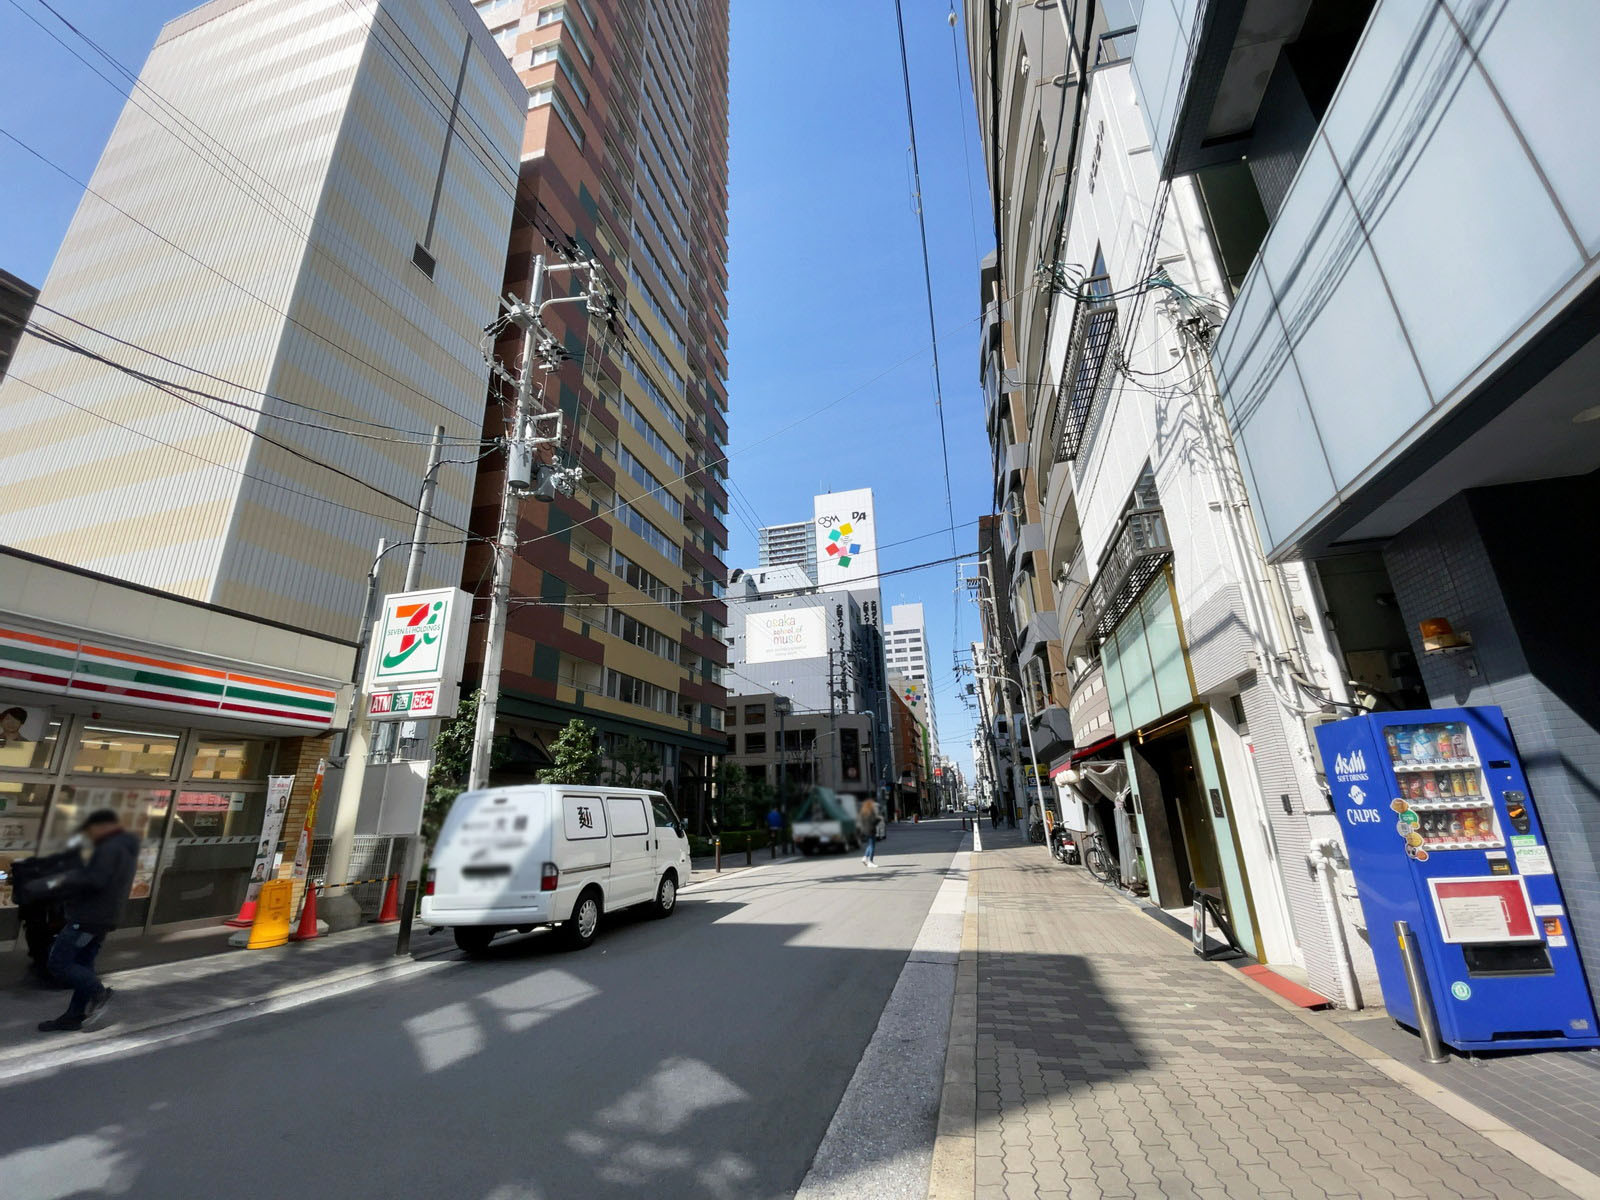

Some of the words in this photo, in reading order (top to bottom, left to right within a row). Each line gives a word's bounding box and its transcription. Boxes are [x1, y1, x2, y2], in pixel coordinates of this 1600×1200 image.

[818, 515, 840, 528] OSM
[852, 512, 866, 523] DA
[412, 624, 440, 633] HOLDINGS
[767, 614, 795, 628] osaka
[774, 634, 801, 645] music
[371, 695, 391, 712] ATM
[395, 694, 410, 710] 酒
[413, 692, 433, 708] たばこ
[1335, 749, 1366, 775] Asahi
[1337, 774, 1349, 782] SOFT
[1349, 773, 1369, 781] DRINKS
[1347, 808, 1381, 825] CALPIS
